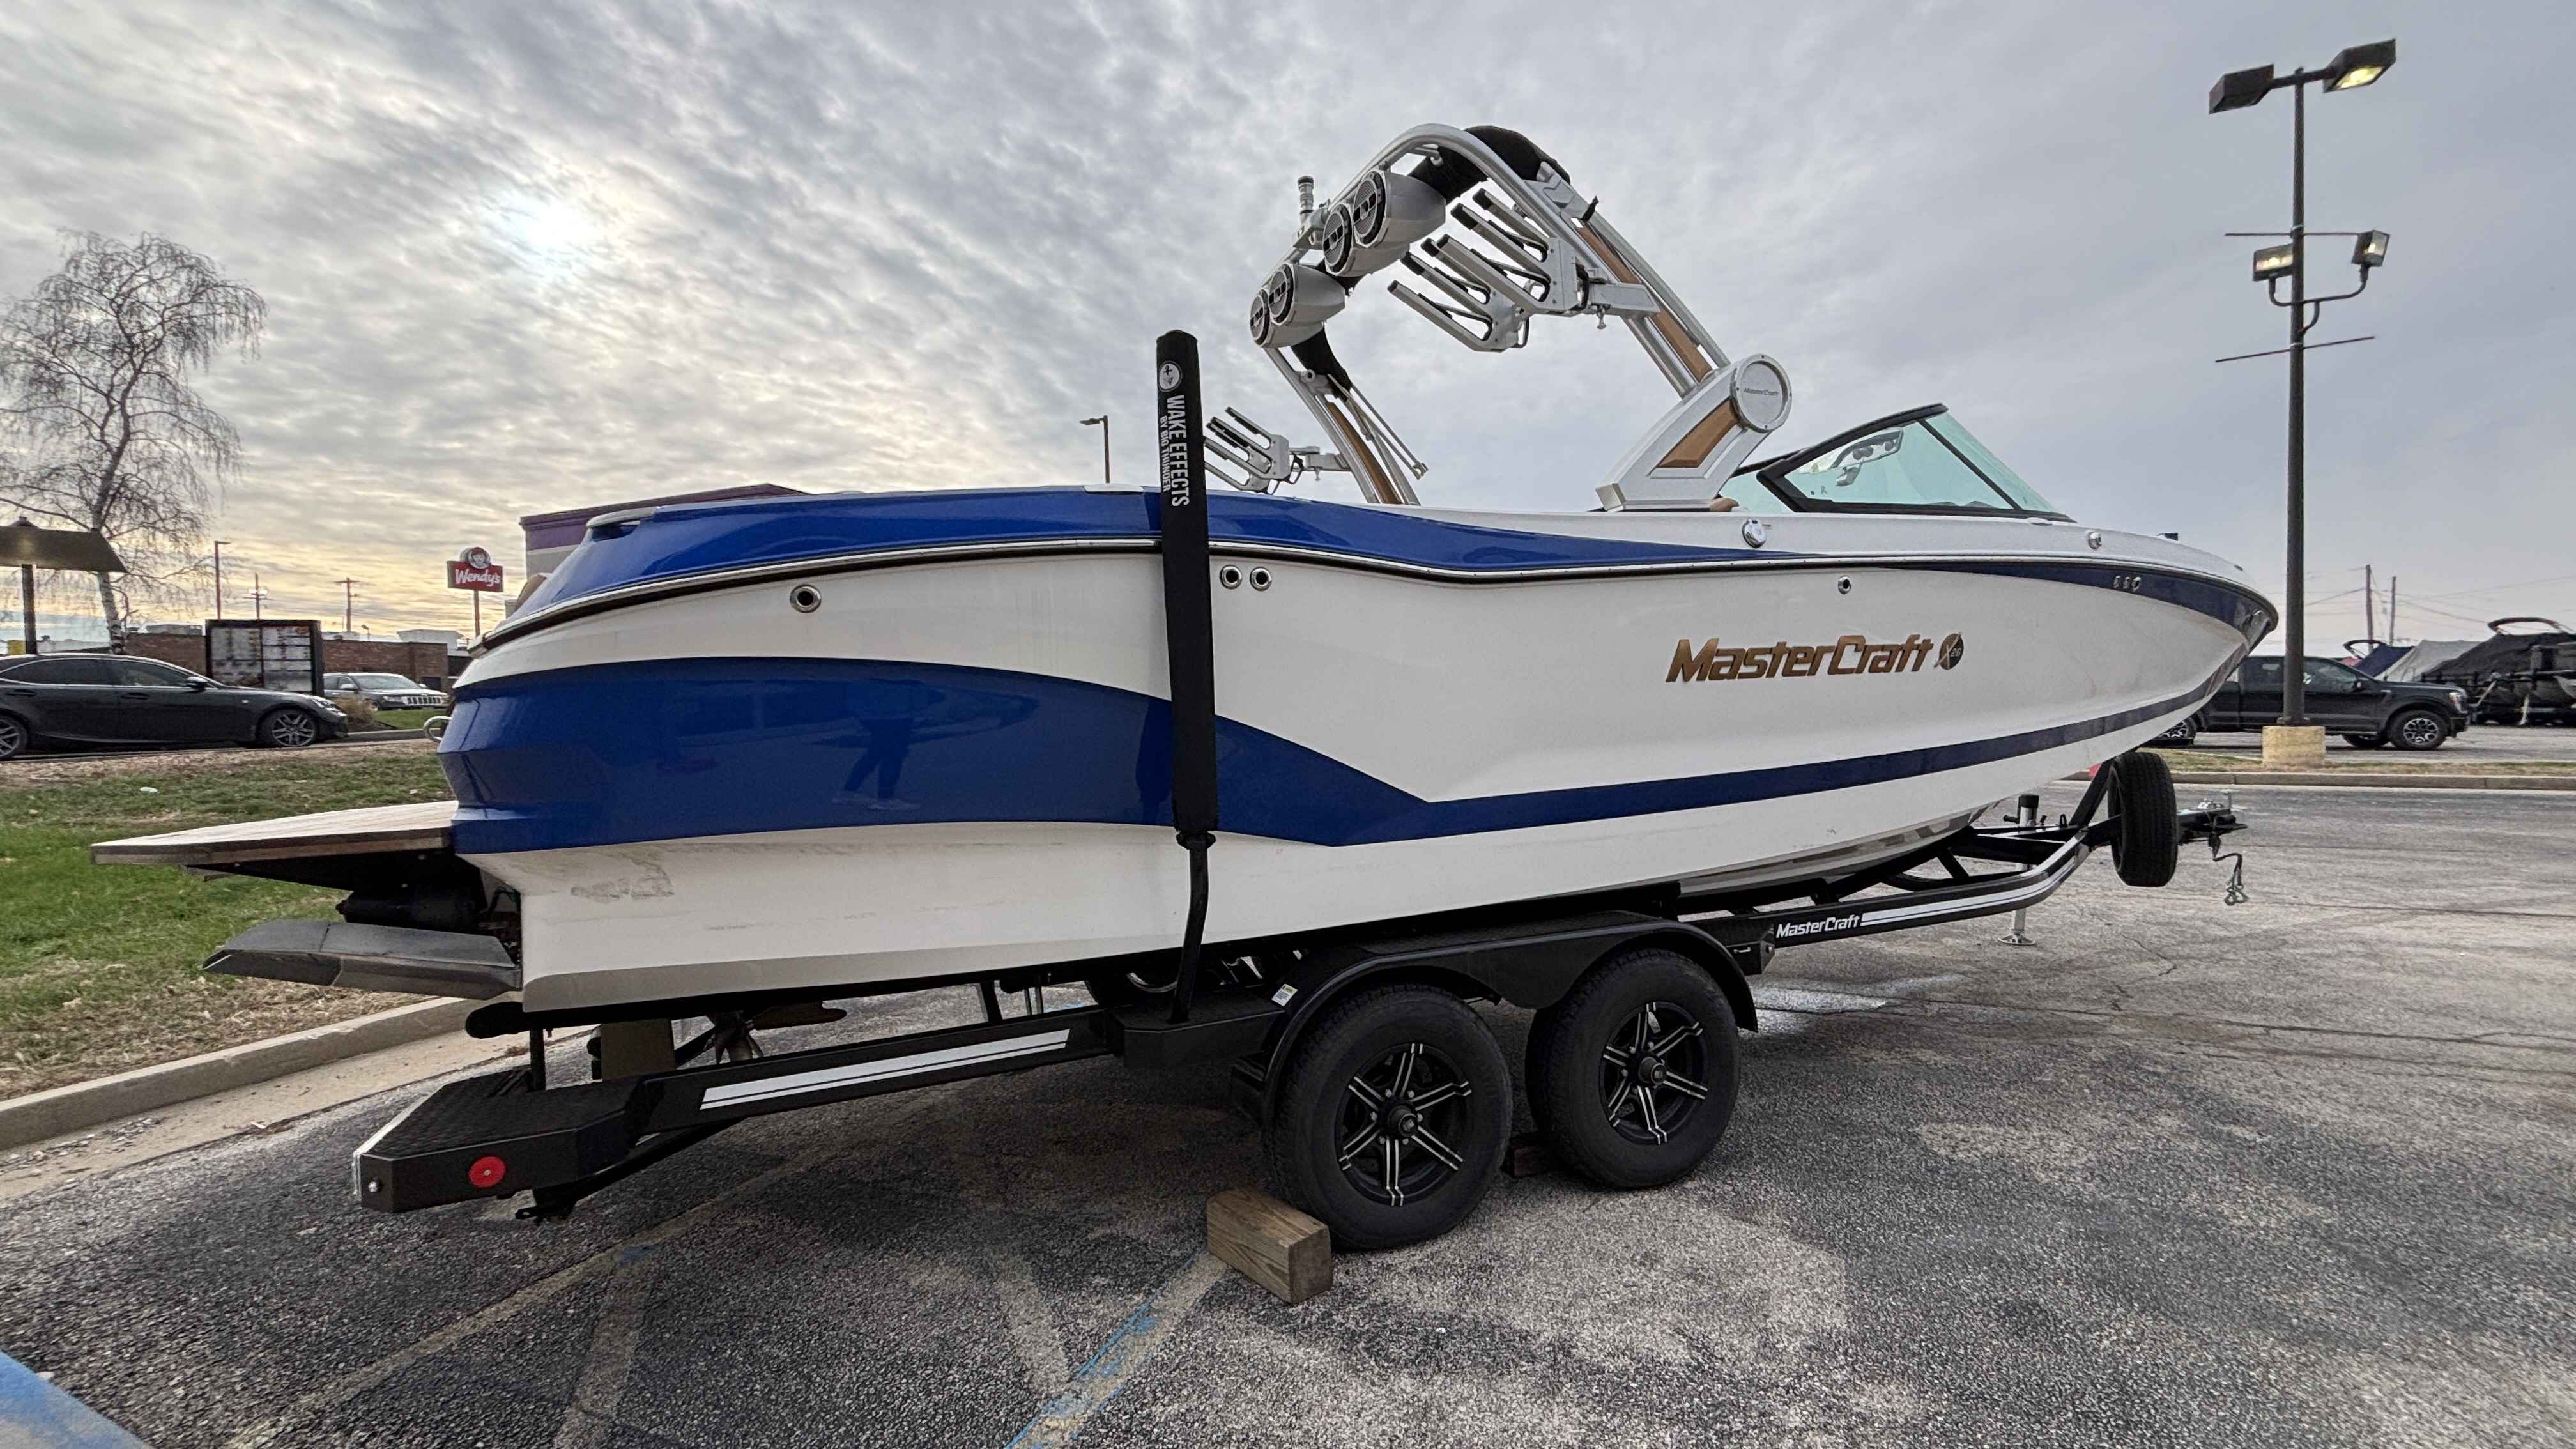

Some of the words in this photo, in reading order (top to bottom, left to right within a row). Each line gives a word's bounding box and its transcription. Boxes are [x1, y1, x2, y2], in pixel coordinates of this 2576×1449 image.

[1160, 415, 1168, 428] BY
[1167, 394, 1187, 440] WAKE
[1162, 447, 1171, 492] THUNDER
[1169, 442, 1190, 506] EFFECTS
[455, 569, 501, 587] Wendy's
[1666, 634, 1933, 682] MasterCraft
[1775, 914, 1860, 938] MasterCraft
